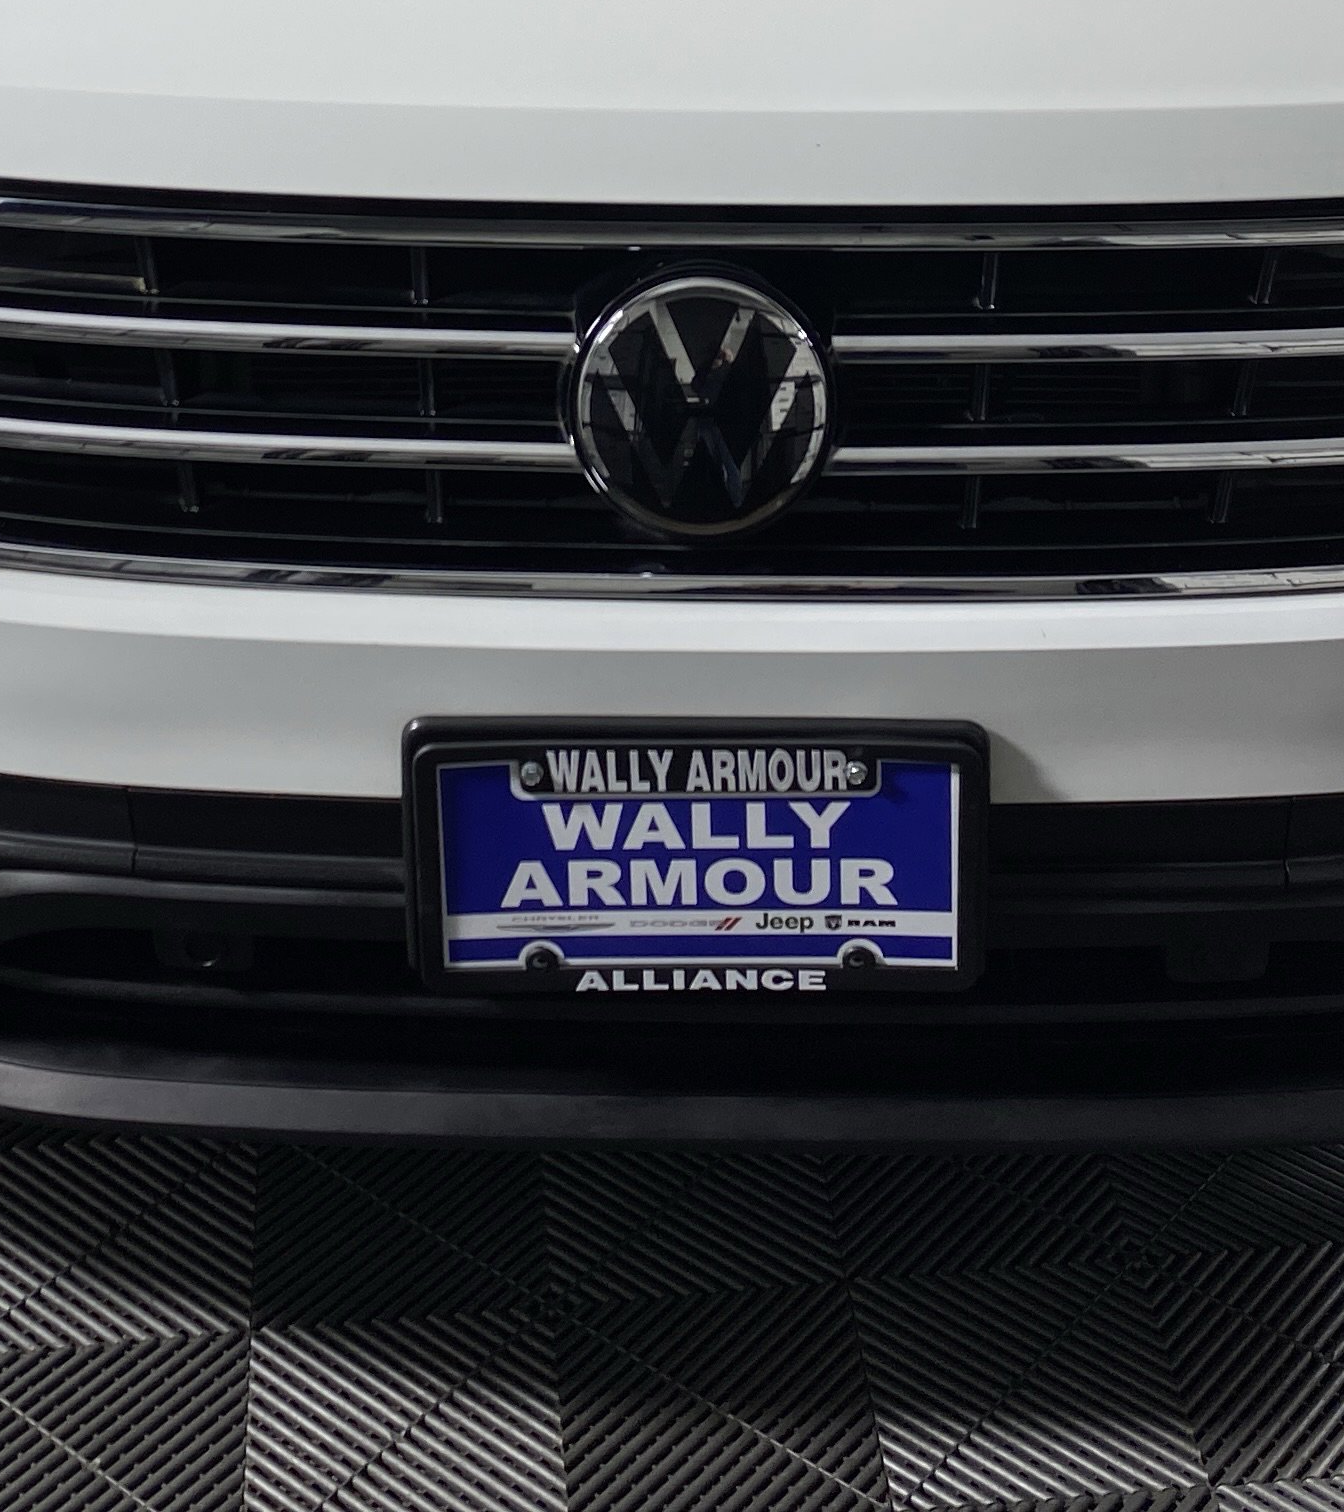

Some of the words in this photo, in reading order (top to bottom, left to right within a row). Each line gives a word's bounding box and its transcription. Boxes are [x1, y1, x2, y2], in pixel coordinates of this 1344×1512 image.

[546, 749, 673, 793] WALLY
[686, 749, 848, 793] ARMOUR
[542, 801, 852, 851] WALLY
[501, 858, 899, 908] ARMOUR
[511, 914, 600, 923] CHRYSLER
[755, 912, 815, 934] Jeep
[846, 919, 897, 928] RAM
[575, 969, 828, 992] ALLIANCE
